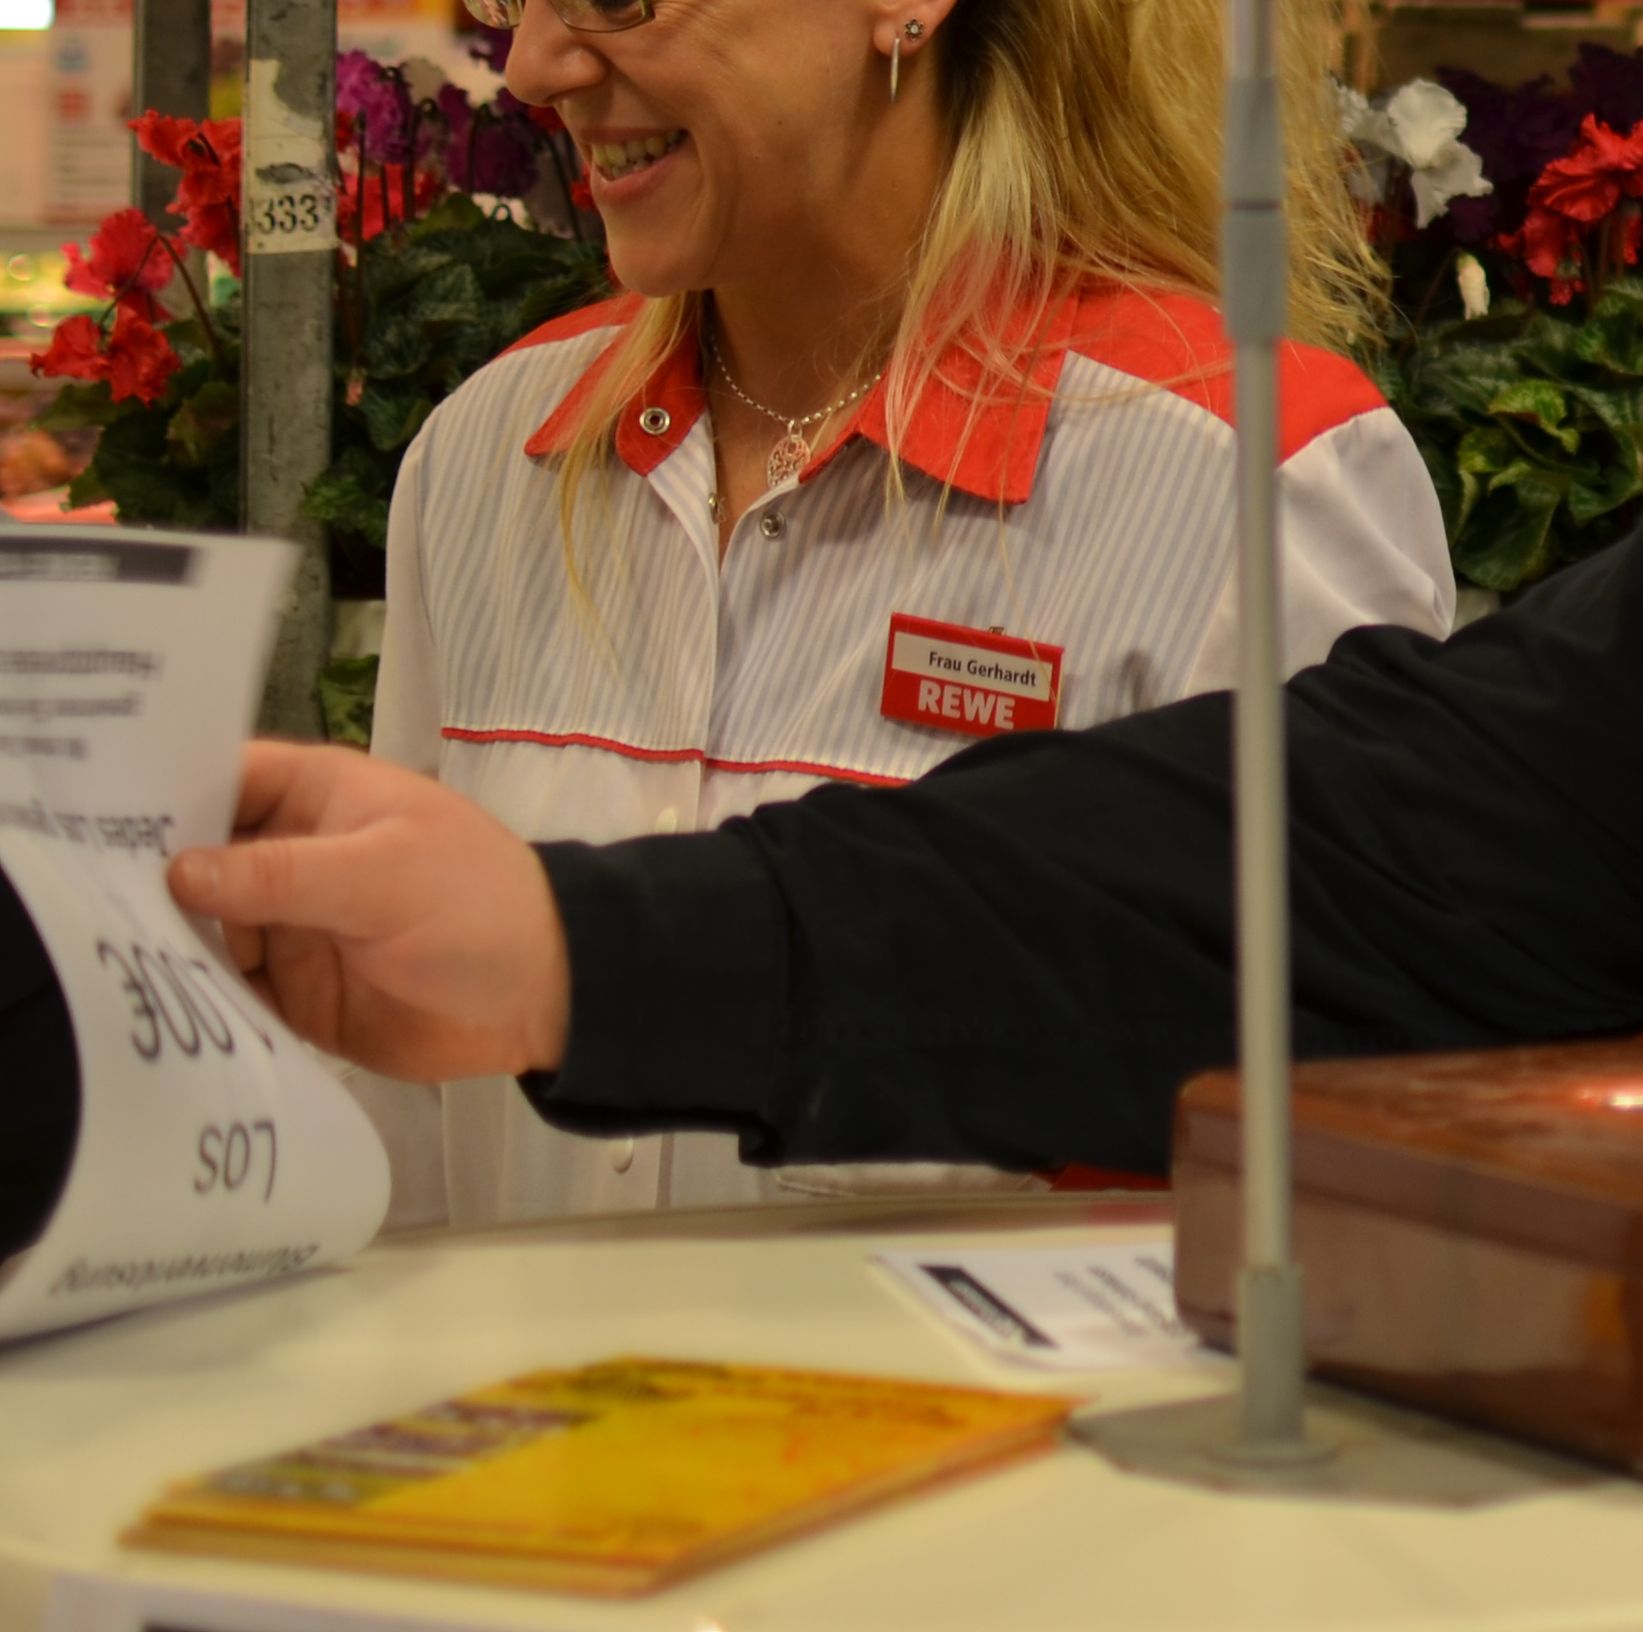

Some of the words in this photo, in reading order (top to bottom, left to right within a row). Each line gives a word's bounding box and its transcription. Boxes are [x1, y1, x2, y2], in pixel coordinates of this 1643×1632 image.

[928, 651, 962, 672] Frau
[967, 659, 1037, 687] Gerhardt
[917, 679, 1016, 730] REWE
[193, 1117, 280, 1205] LOS
